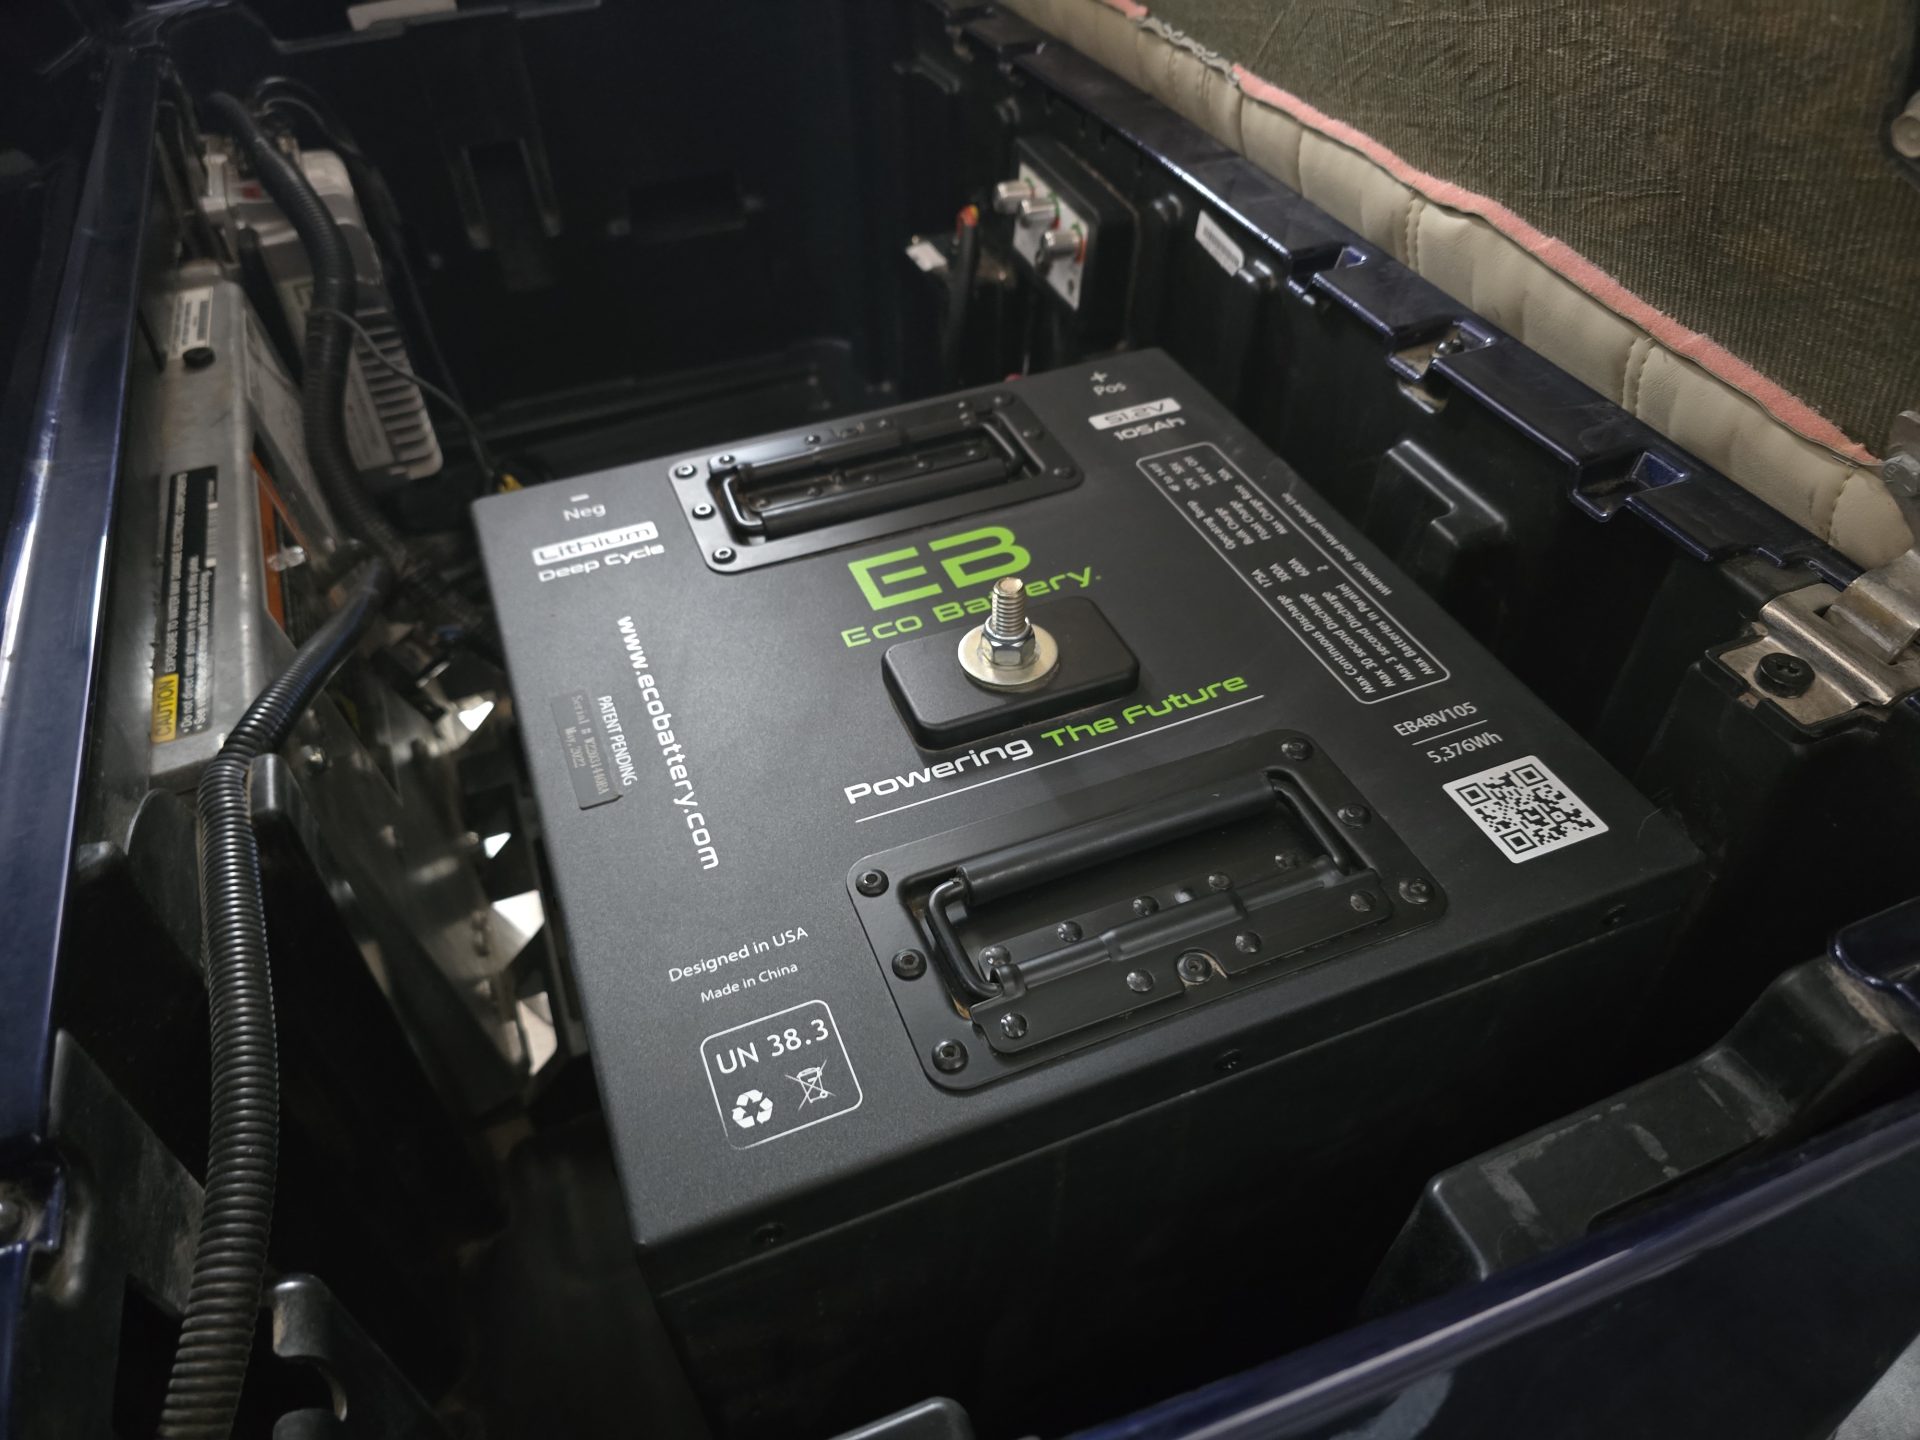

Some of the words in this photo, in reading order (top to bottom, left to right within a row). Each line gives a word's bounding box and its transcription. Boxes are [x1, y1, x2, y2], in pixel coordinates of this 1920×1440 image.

[1093, 382, 1126, 396] Pos
[1114, 417, 1186, 441] 105Ah
[1235, 485, 1252, 500] Rate
[563, 503, 606, 522] Neg
[1187, 501, 1205, 519] Temp
[1215, 508, 1239, 530] Charge
[1230, 501, 1254, 523] Charge
[1249, 499, 1274, 521] Charge
[1203, 517, 1236, 549] Operating
[1251, 522, 1271, 540] Float
[1272, 520, 1287, 534] Max
[538, 527, 652, 562] Lithium
[538, 559, 600, 582] Deep
[604, 543, 664, 566] Cycle
[848, 526, 1030, 611] EB
[1269, 563, 1292, 582] 300A
[1288, 558, 1310, 576] 600A
[1316, 564, 1330, 573] 2
[1251, 569, 1272, 587] 175A
[841, 615, 923, 648] Eco
[933, 566, 1092, 623] Baery
[1322, 592, 1362, 628] Discharge
[1336, 583, 1370, 612] Parallel
[1277, 595, 1315, 631] Discharge
[1300, 593, 1339, 630] Discharge
[1333, 630, 1367, 657] second
[1356, 628, 1390, 656] second
[1376, 621, 1417, 657] Batteries
[1312, 631, 1357, 675] Continuous
[1361, 658, 1378, 669] 30
[1384, 655, 1398, 664] 3
[1413, 657, 1435, 674] Max
[1374, 669, 1396, 687] Max
[1394, 663, 1416, 680] Max
[1355, 676, 1376, 693] Max
[156, 679, 176, 736] CAUTION
[182, 701, 194, 715] not
[194, 709, 206, 725] See
[571, 695, 590, 724] Serial
[1393, 702, 1477, 736] EB48V105
[181, 715, 193, 728] Do
[597, 696, 622, 733] PATENT
[610, 734, 637, 786] PENDING
[617, 615, 719, 870] www.ecobattery.com
[843, 739, 1033, 804] Powering
[1041, 718, 1119, 747] The
[1122, 676, 1248, 725] Future
[1427, 731, 1503, 763] 5,376Wh
[668, 945, 750, 982] Designed
[753, 940, 770, 954] in
[772, 927, 809, 947] USA
[700, 982, 740, 1003] Made
[742, 976, 756, 989] in
[758, 963, 798, 983] China
[716, 1042, 759, 1074] UN
[767, 1019, 828, 1057] 38.3
